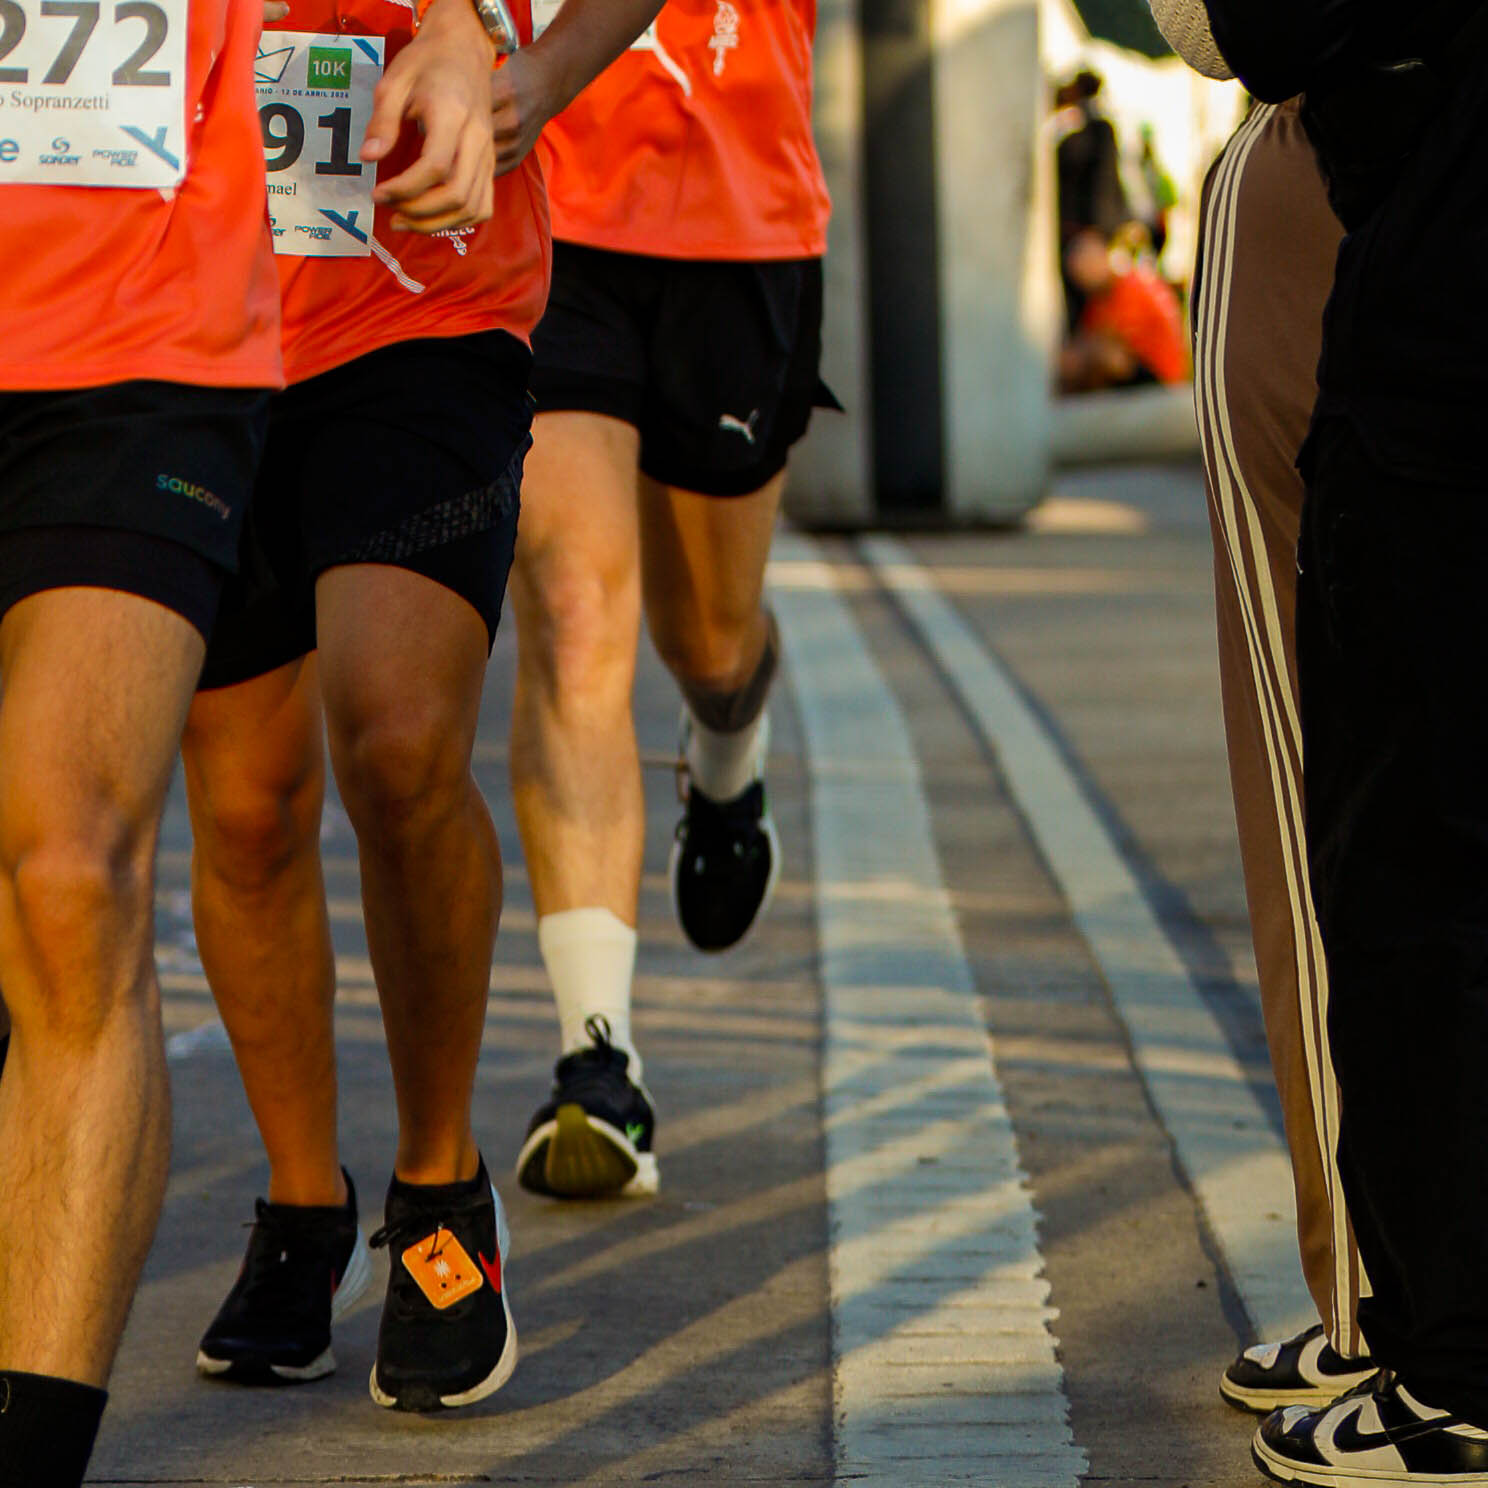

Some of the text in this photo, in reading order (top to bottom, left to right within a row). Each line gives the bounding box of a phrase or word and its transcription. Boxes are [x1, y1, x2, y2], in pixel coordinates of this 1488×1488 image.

[312, 60, 346, 77] 10K
[10, 89, 110, 112] Sopranzetti
[281, 88, 290, 96] 12
[292, 89, 303, 97] DE
[305, 89, 328, 98] ABRIL
[258, 102, 362, 177] 91
